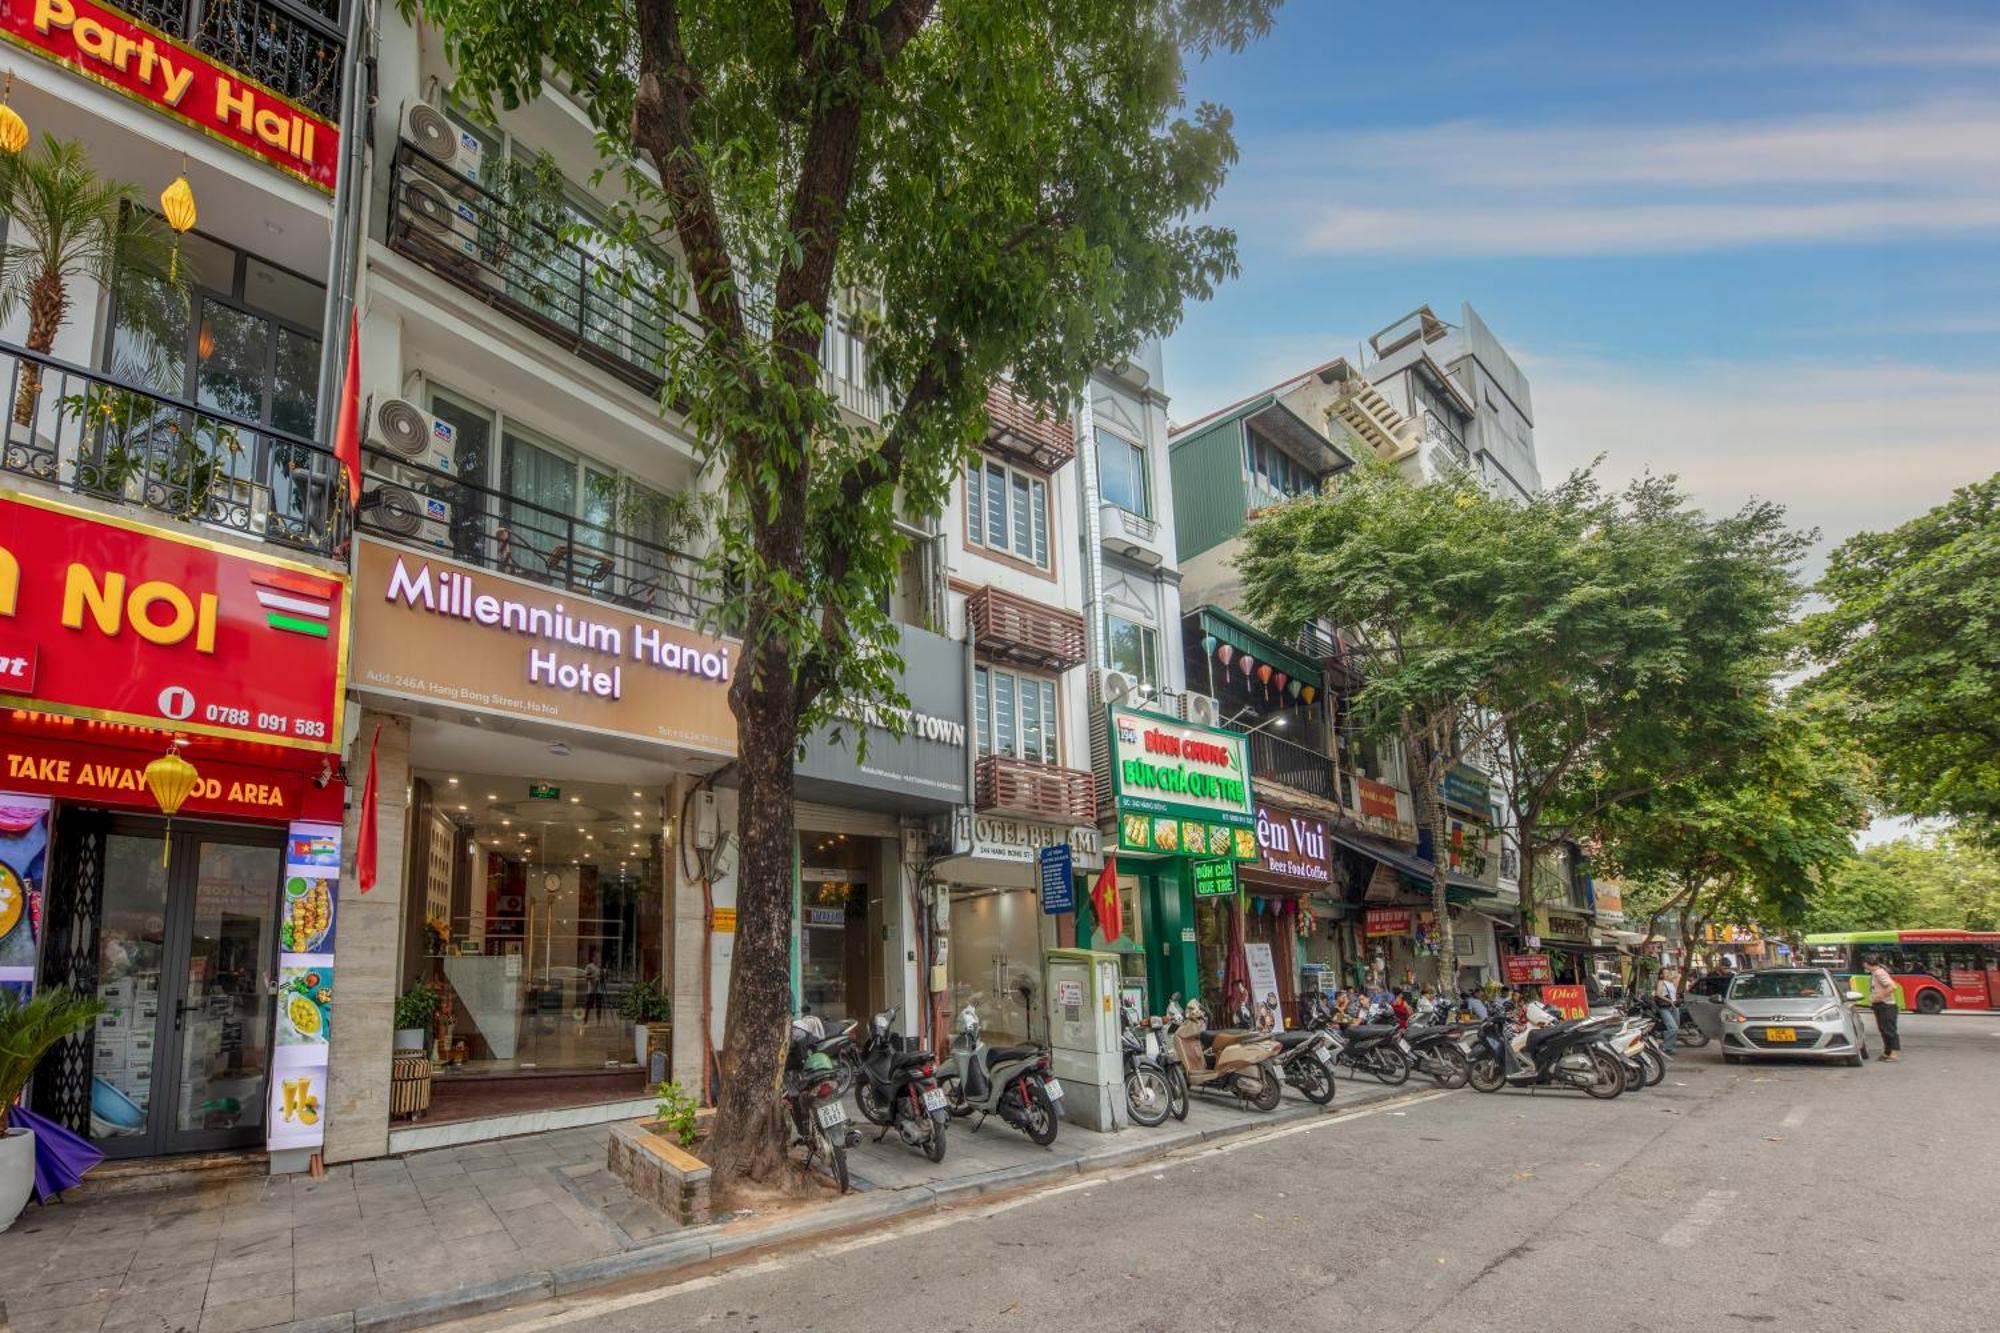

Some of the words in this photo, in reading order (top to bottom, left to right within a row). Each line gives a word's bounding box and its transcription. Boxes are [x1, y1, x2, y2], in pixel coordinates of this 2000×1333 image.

[33, 0, 194, 107] Party
[216, 77, 315, 162] Hall
[385, 555, 621, 656] Millennium
[633, 624, 729, 682] Hanoi
[529, 648, 621, 699] Hotel
[460, 687, 490, 704] Bong
[206, 704, 249, 726] 0788
[257, 713, 288, 732] 091
[295, 719, 325, 738] 583
[915, 713, 965, 747] TOWN
[7, 754, 70, 782] TAKE
[77, 763, 148, 792] AWAY
[227, 782, 284, 806] AREA
[1066, 830, 1097, 855] AMI
[1290, 818, 1326, 860] Vui
